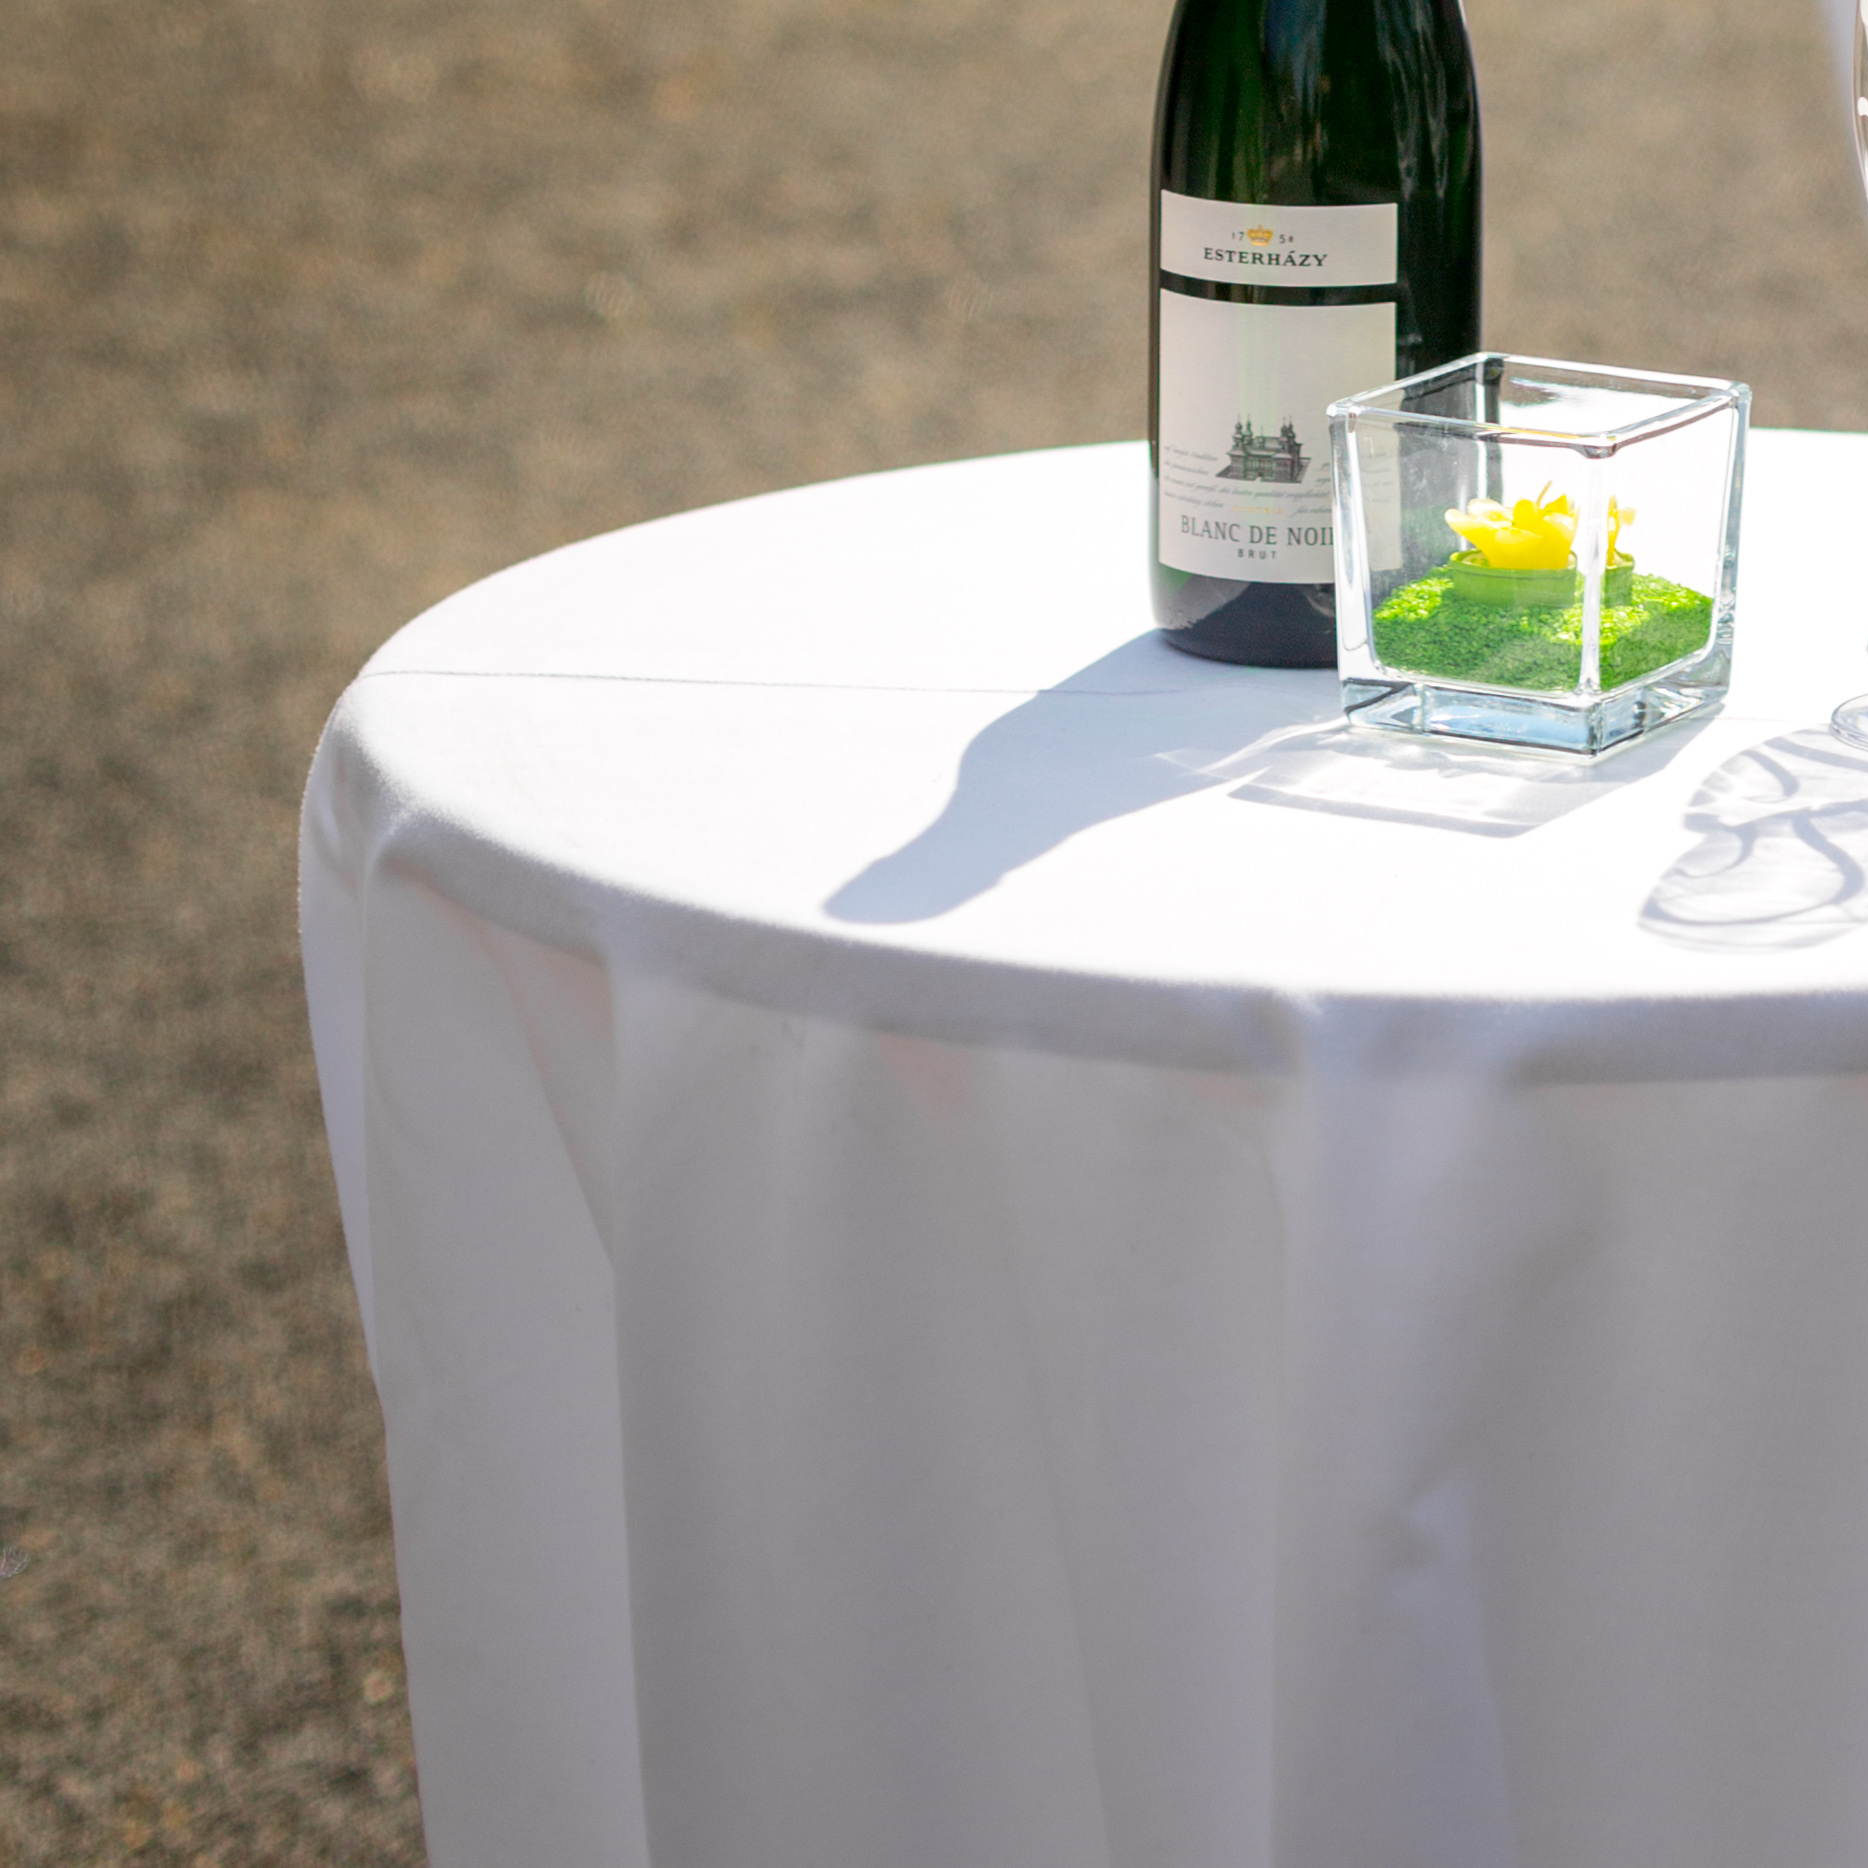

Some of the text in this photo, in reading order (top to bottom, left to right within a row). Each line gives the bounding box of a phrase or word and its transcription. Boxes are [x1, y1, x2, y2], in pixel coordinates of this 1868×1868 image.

[1203, 246, 1328, 267] ESTERHÁZY
[1180, 514, 1241, 543] BLANC
[1248, 524, 1278, 546] DE
[1236, 548, 1278, 560] BRUT
